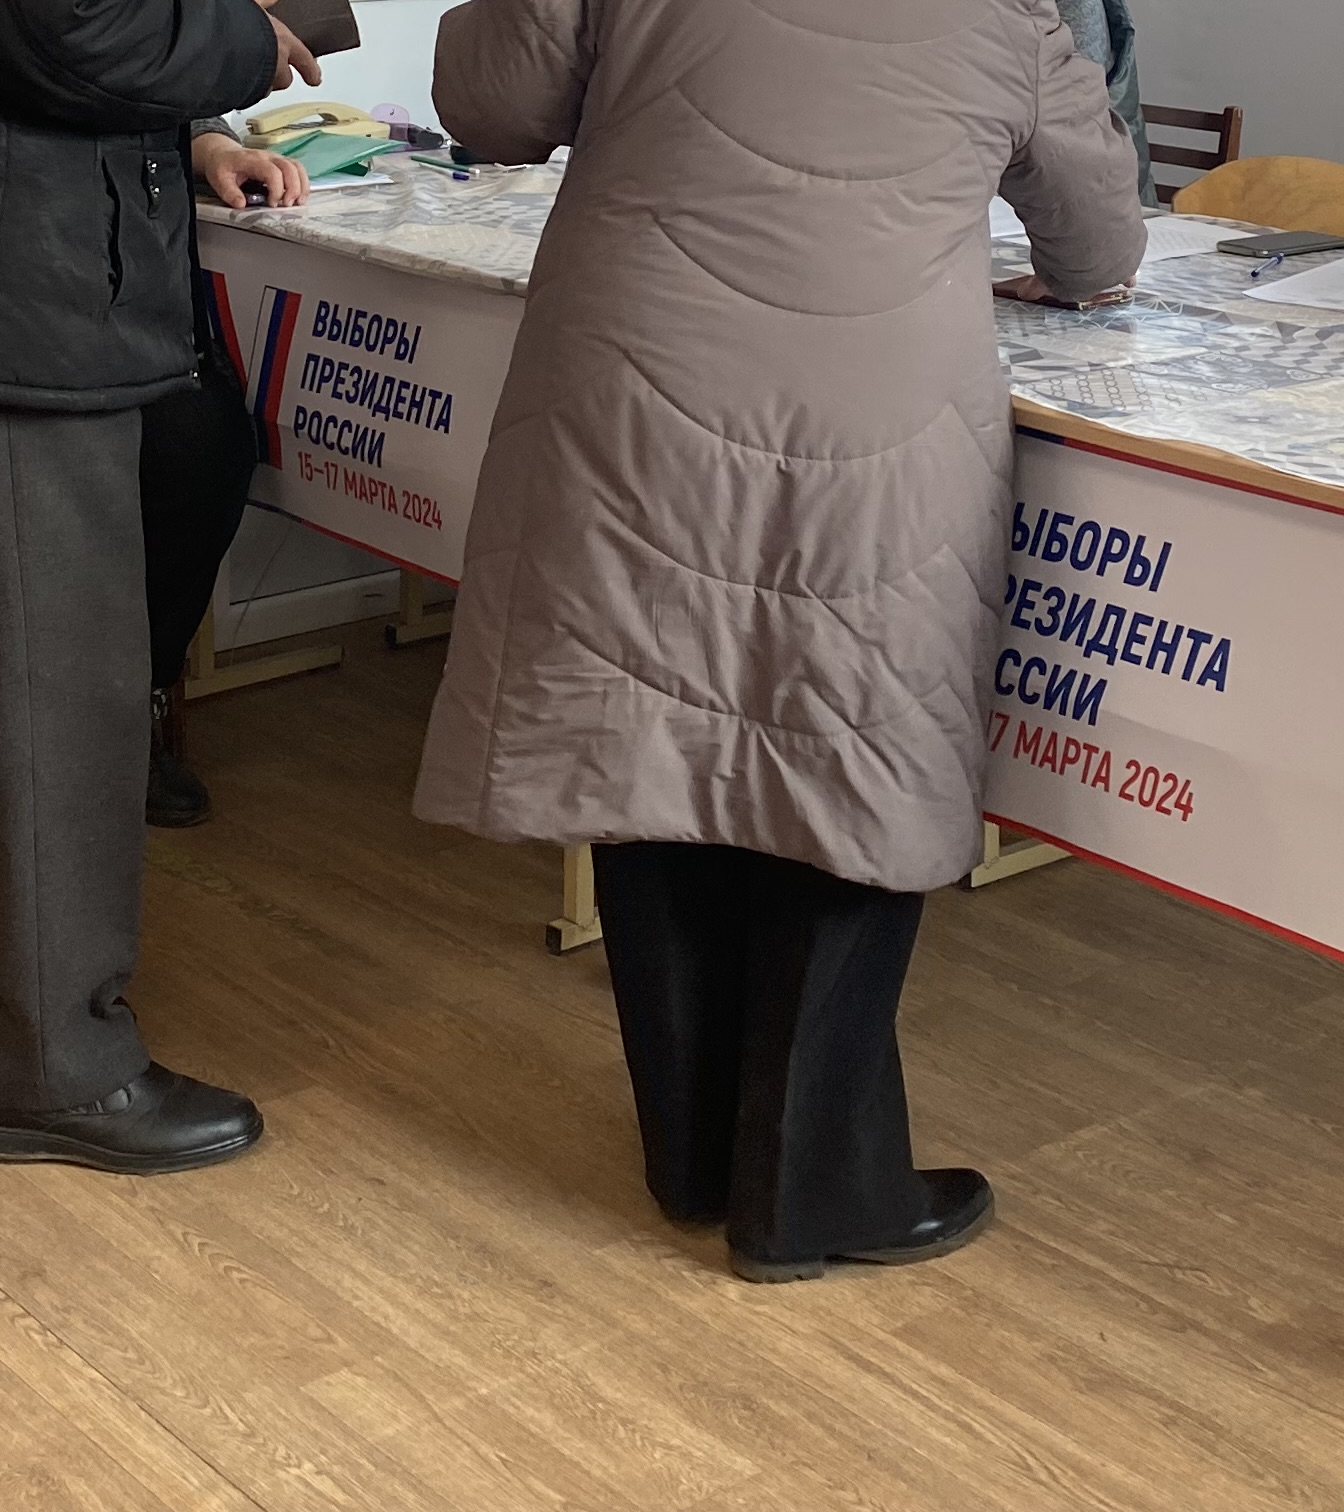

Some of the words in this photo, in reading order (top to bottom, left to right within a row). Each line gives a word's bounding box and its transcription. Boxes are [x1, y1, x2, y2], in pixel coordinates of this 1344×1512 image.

[311, 299, 422, 364] ВЫБОРЫ
[299, 352, 454, 435] ПРЕЗИДЕНТА
[293, 404, 386, 468] РОССИИ
[343, 469, 399, 515] МАРТА
[402, 490, 443, 531] 2024
[1011, 502, 1173, 592] ЫБОРЫ
[1004, 573, 1232, 693] ЕЗИДЕНТА
[994, 648, 1108, 727] ССИИ
[1012, 719, 1111, 793] МАРТА
[1118, 758, 1195, 822] 2024
